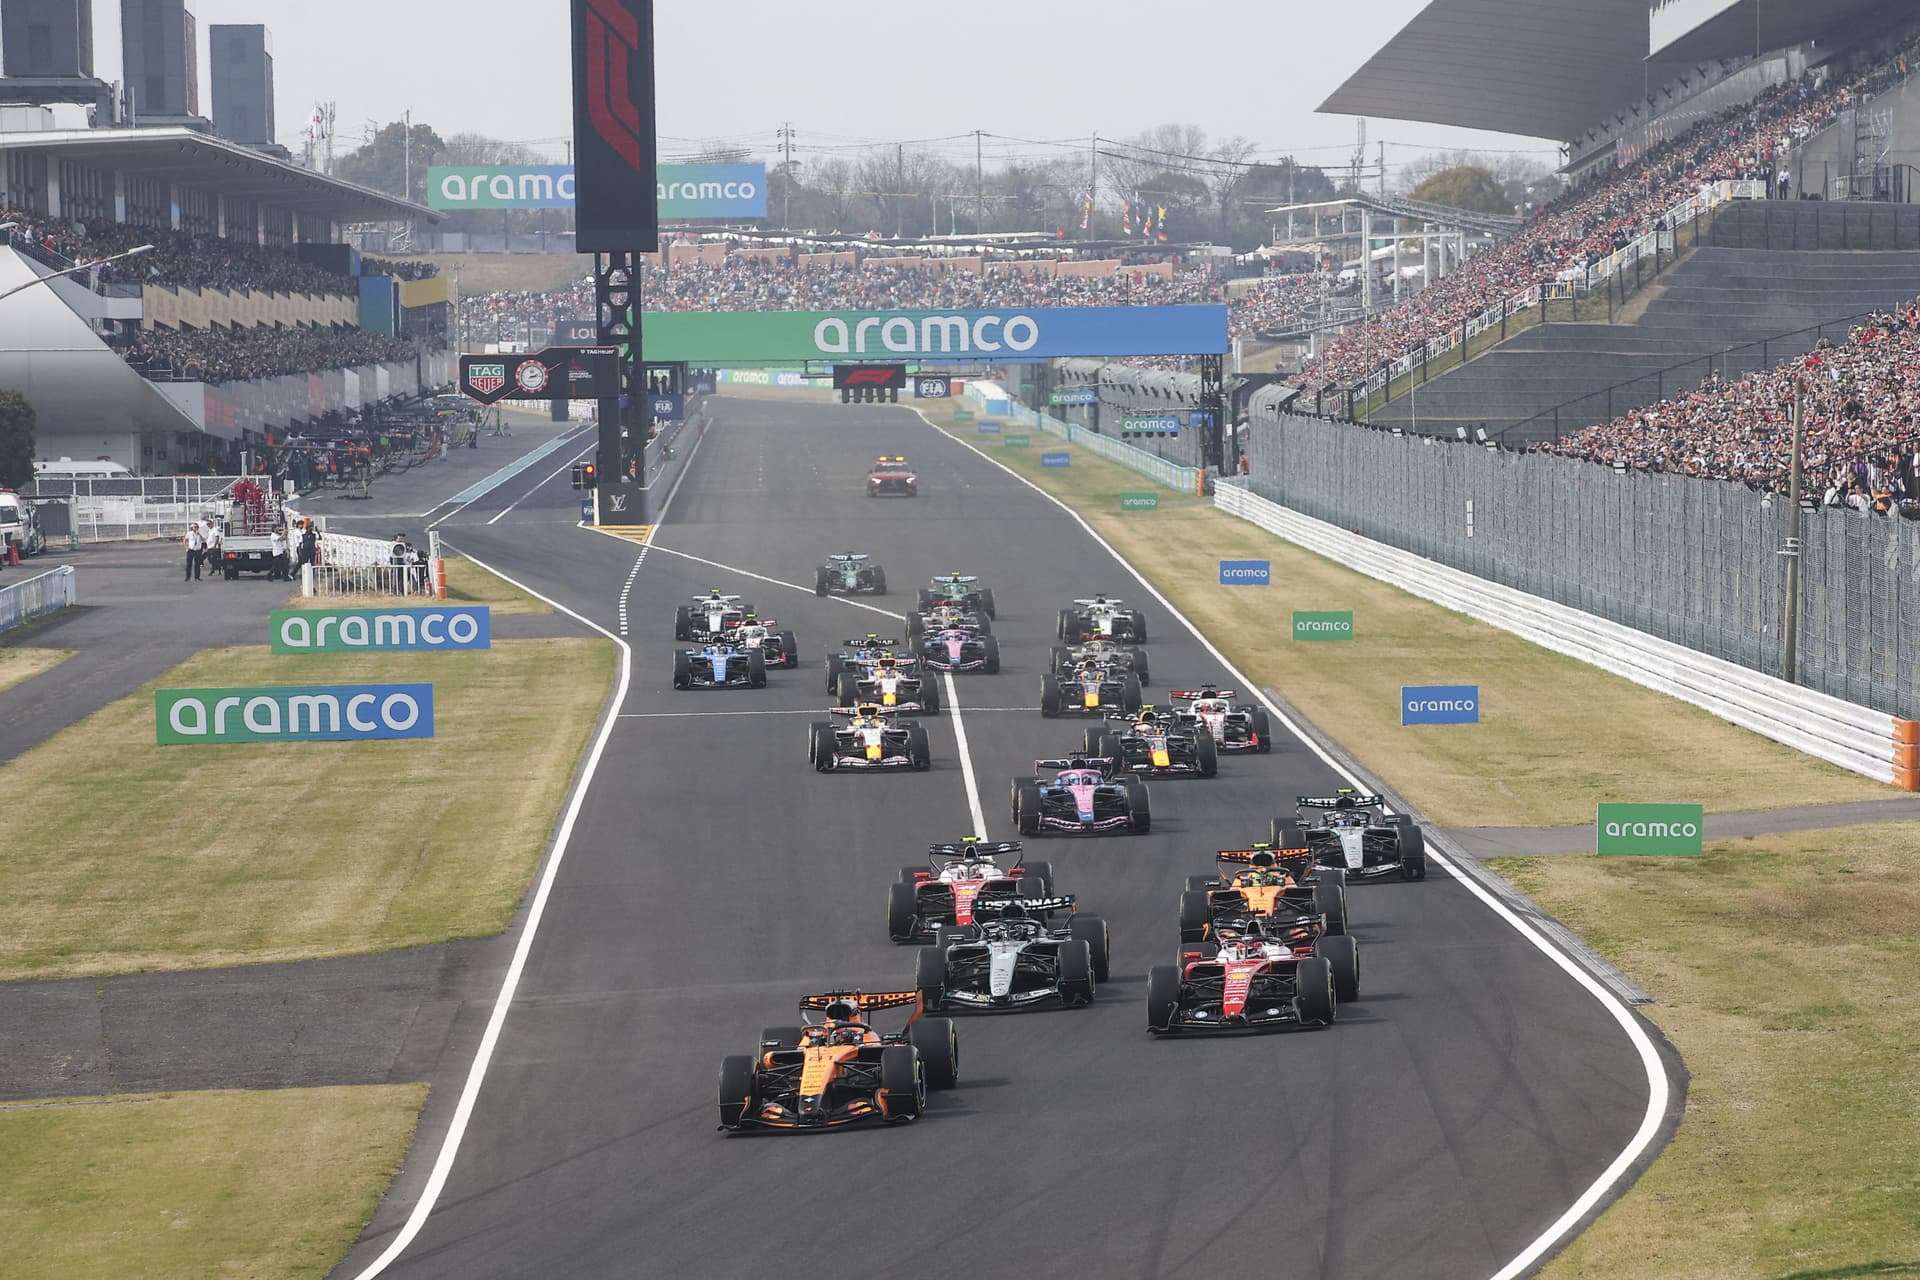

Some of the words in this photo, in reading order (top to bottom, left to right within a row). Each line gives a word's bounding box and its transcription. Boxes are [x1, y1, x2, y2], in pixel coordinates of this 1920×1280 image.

[441, 174, 576, 200] aramc
[814, 315, 1038, 353] aramco
[472, 367, 501, 376] TAG
[471, 378, 502, 392] HEUER
[922, 383, 945, 395] FIA
[1052, 393, 1093, 402] aramco
[1124, 419, 1175, 430] aramco
[1223, 569, 1268, 577] aramco
[281, 613, 479, 648] aramco
[1296, 621, 1350, 632] aramco
[1407, 699, 1475, 712] aramco
[169, 693, 419, 735] aramco
[1605, 822, 1697, 837] aramco
